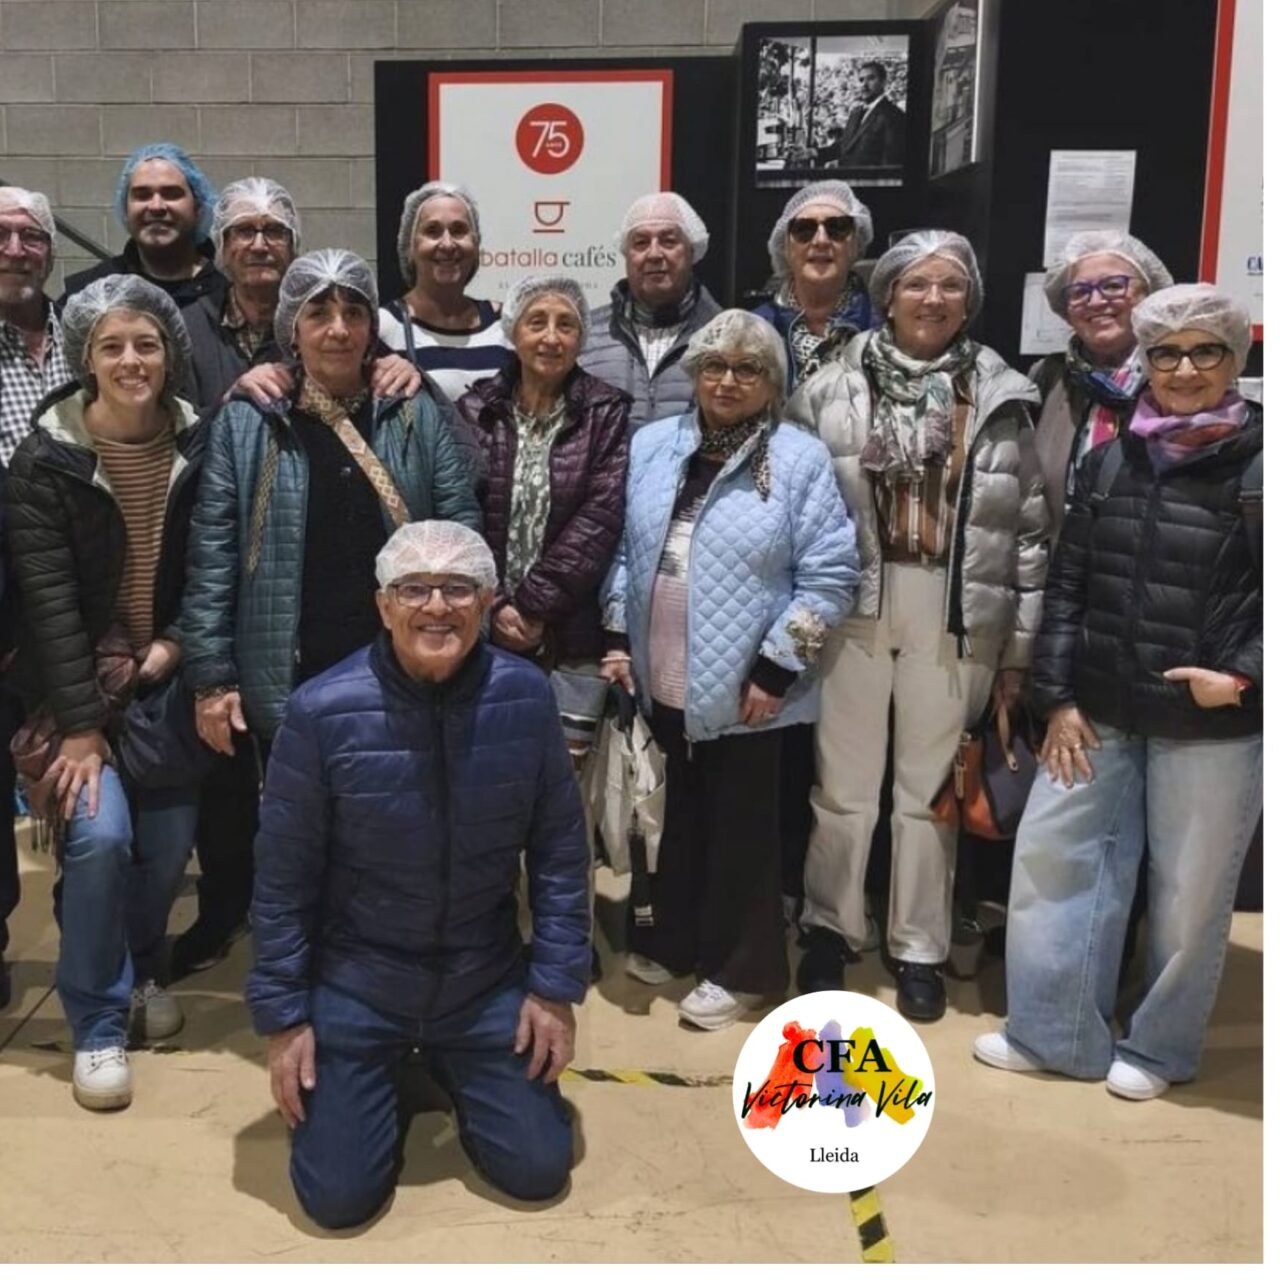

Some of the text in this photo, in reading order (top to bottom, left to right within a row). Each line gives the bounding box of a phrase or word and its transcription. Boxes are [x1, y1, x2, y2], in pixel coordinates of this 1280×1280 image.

[530, 120, 570, 158] 75
[480, 245, 616, 268] batalla cafés
